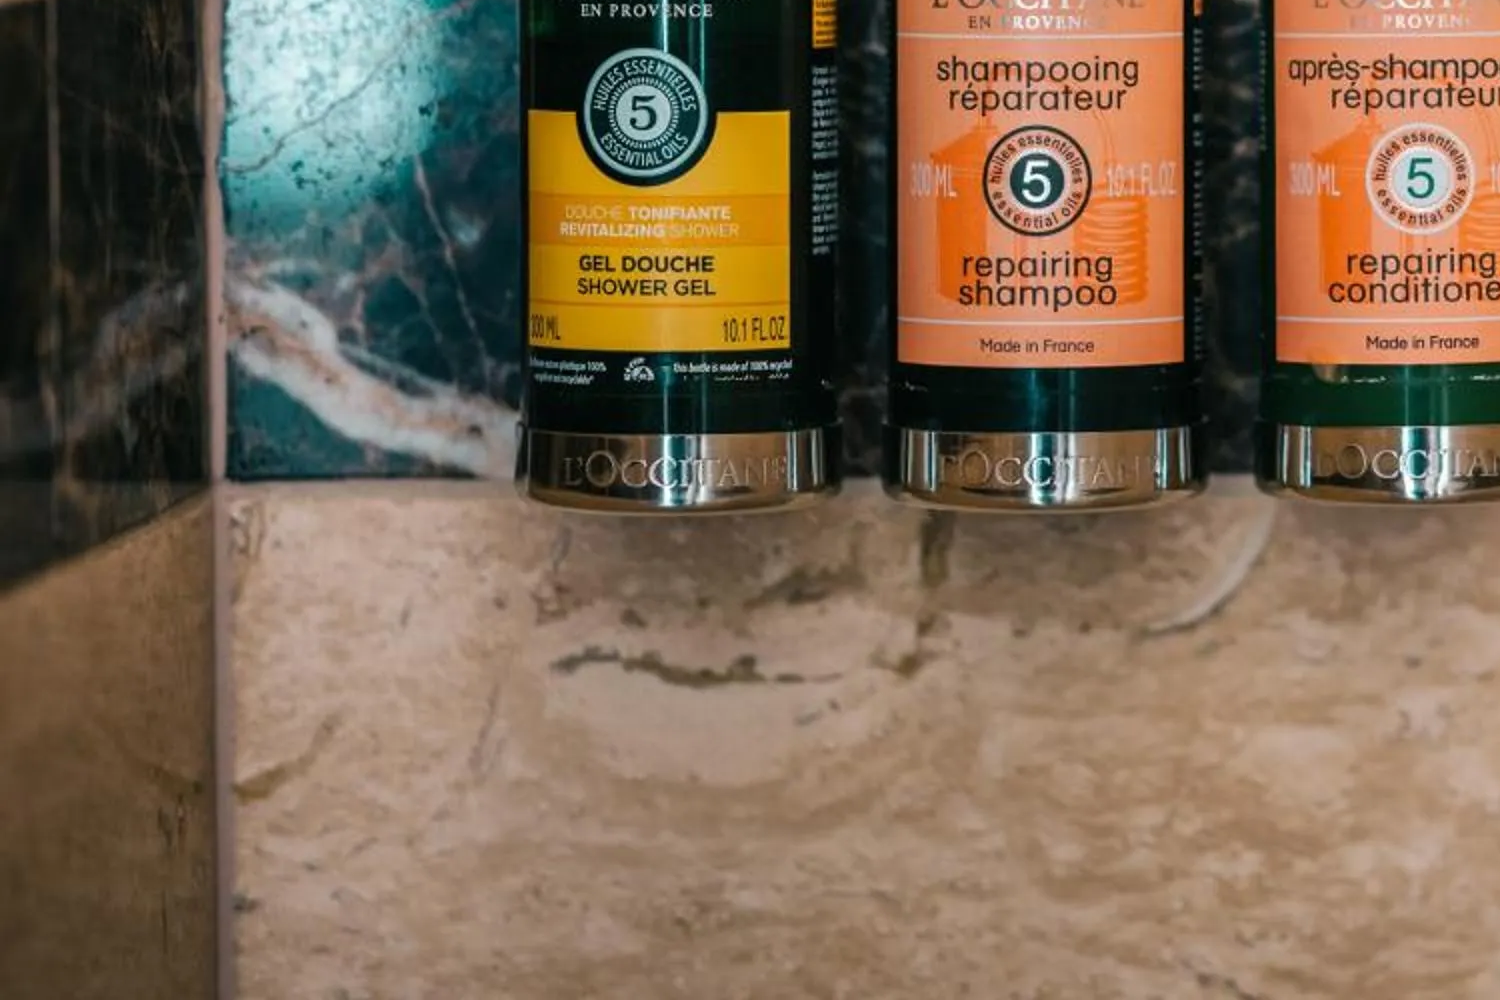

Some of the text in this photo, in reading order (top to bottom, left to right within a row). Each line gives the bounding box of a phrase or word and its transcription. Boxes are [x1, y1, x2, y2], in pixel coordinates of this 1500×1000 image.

[581, 3, 714, 18] EN PROVENCE
[968, 15, 991, 29] EN
[594, 59, 697, 112] HUILES ESSENTIELLES
[937, 56, 1139, 87] shampooing
[629, 95, 657, 131] 5
[949, 83, 1127, 116] réparateur
[601, 132, 689, 166] ESSENTIAL OILS
[989, 134, 1082, 184] huiles essentielles
[1373, 133, 1467, 181] huiles essentielles
[936, 164, 957, 197] ML
[1021, 159, 1052, 204] 5
[1317, 162, 1341, 197] ML
[1406, 157, 1435, 199] 5
[565, 205, 732, 221] DOUCHE TONIFIANTE
[993, 191, 1083, 229] essential oils
[1377, 187, 1467, 226] essential oils
[560, 221, 740, 238] REVITALIZING SHOWER
[579, 255, 715, 273] GEL DOUCHE
[962, 252, 1113, 282] repairing
[1347, 248, 1496, 280] repairing
[577, 278, 716, 296] SHOWER GEL
[959, 280, 1118, 312] shampoo
[546, 315, 561, 340] ML
[723, 318, 747, 343] 10.1
[1365, 335, 1480, 350] Made in France
[980, 339, 1095, 353] Made in France
